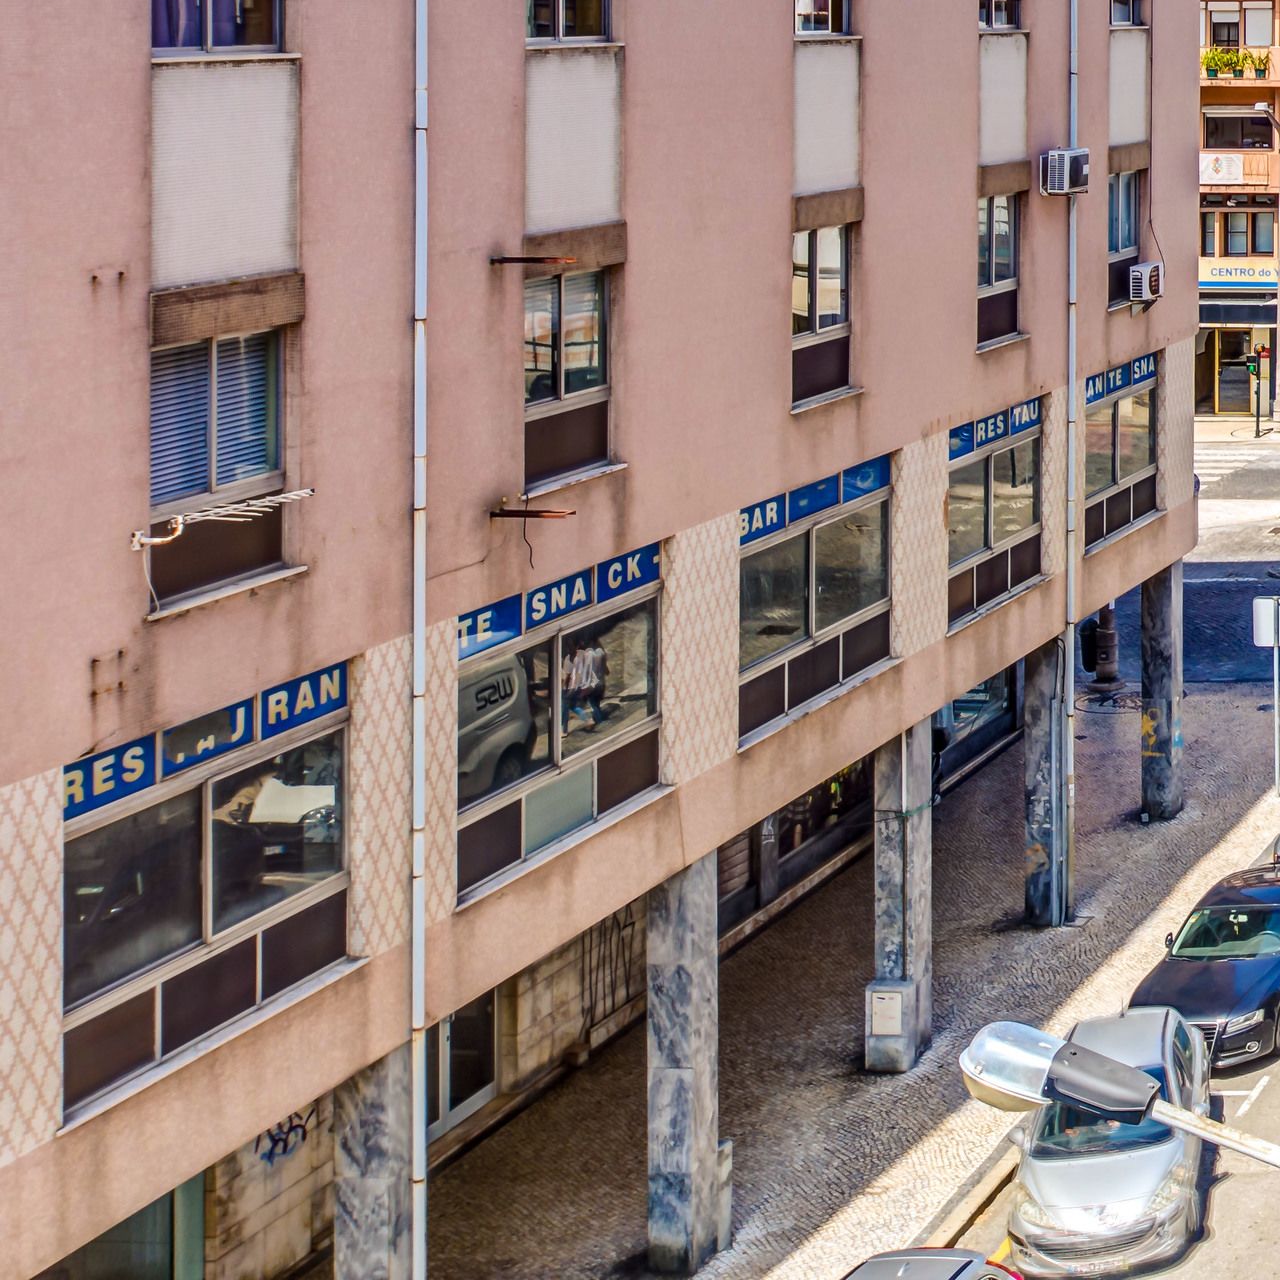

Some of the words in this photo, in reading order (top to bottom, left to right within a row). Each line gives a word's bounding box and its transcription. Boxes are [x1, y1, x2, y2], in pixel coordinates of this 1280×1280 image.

[1211, 267, 1255, 277] CENTRO
[1258, 268, 1271, 277] do
[740, 500, 779, 540] BAR
